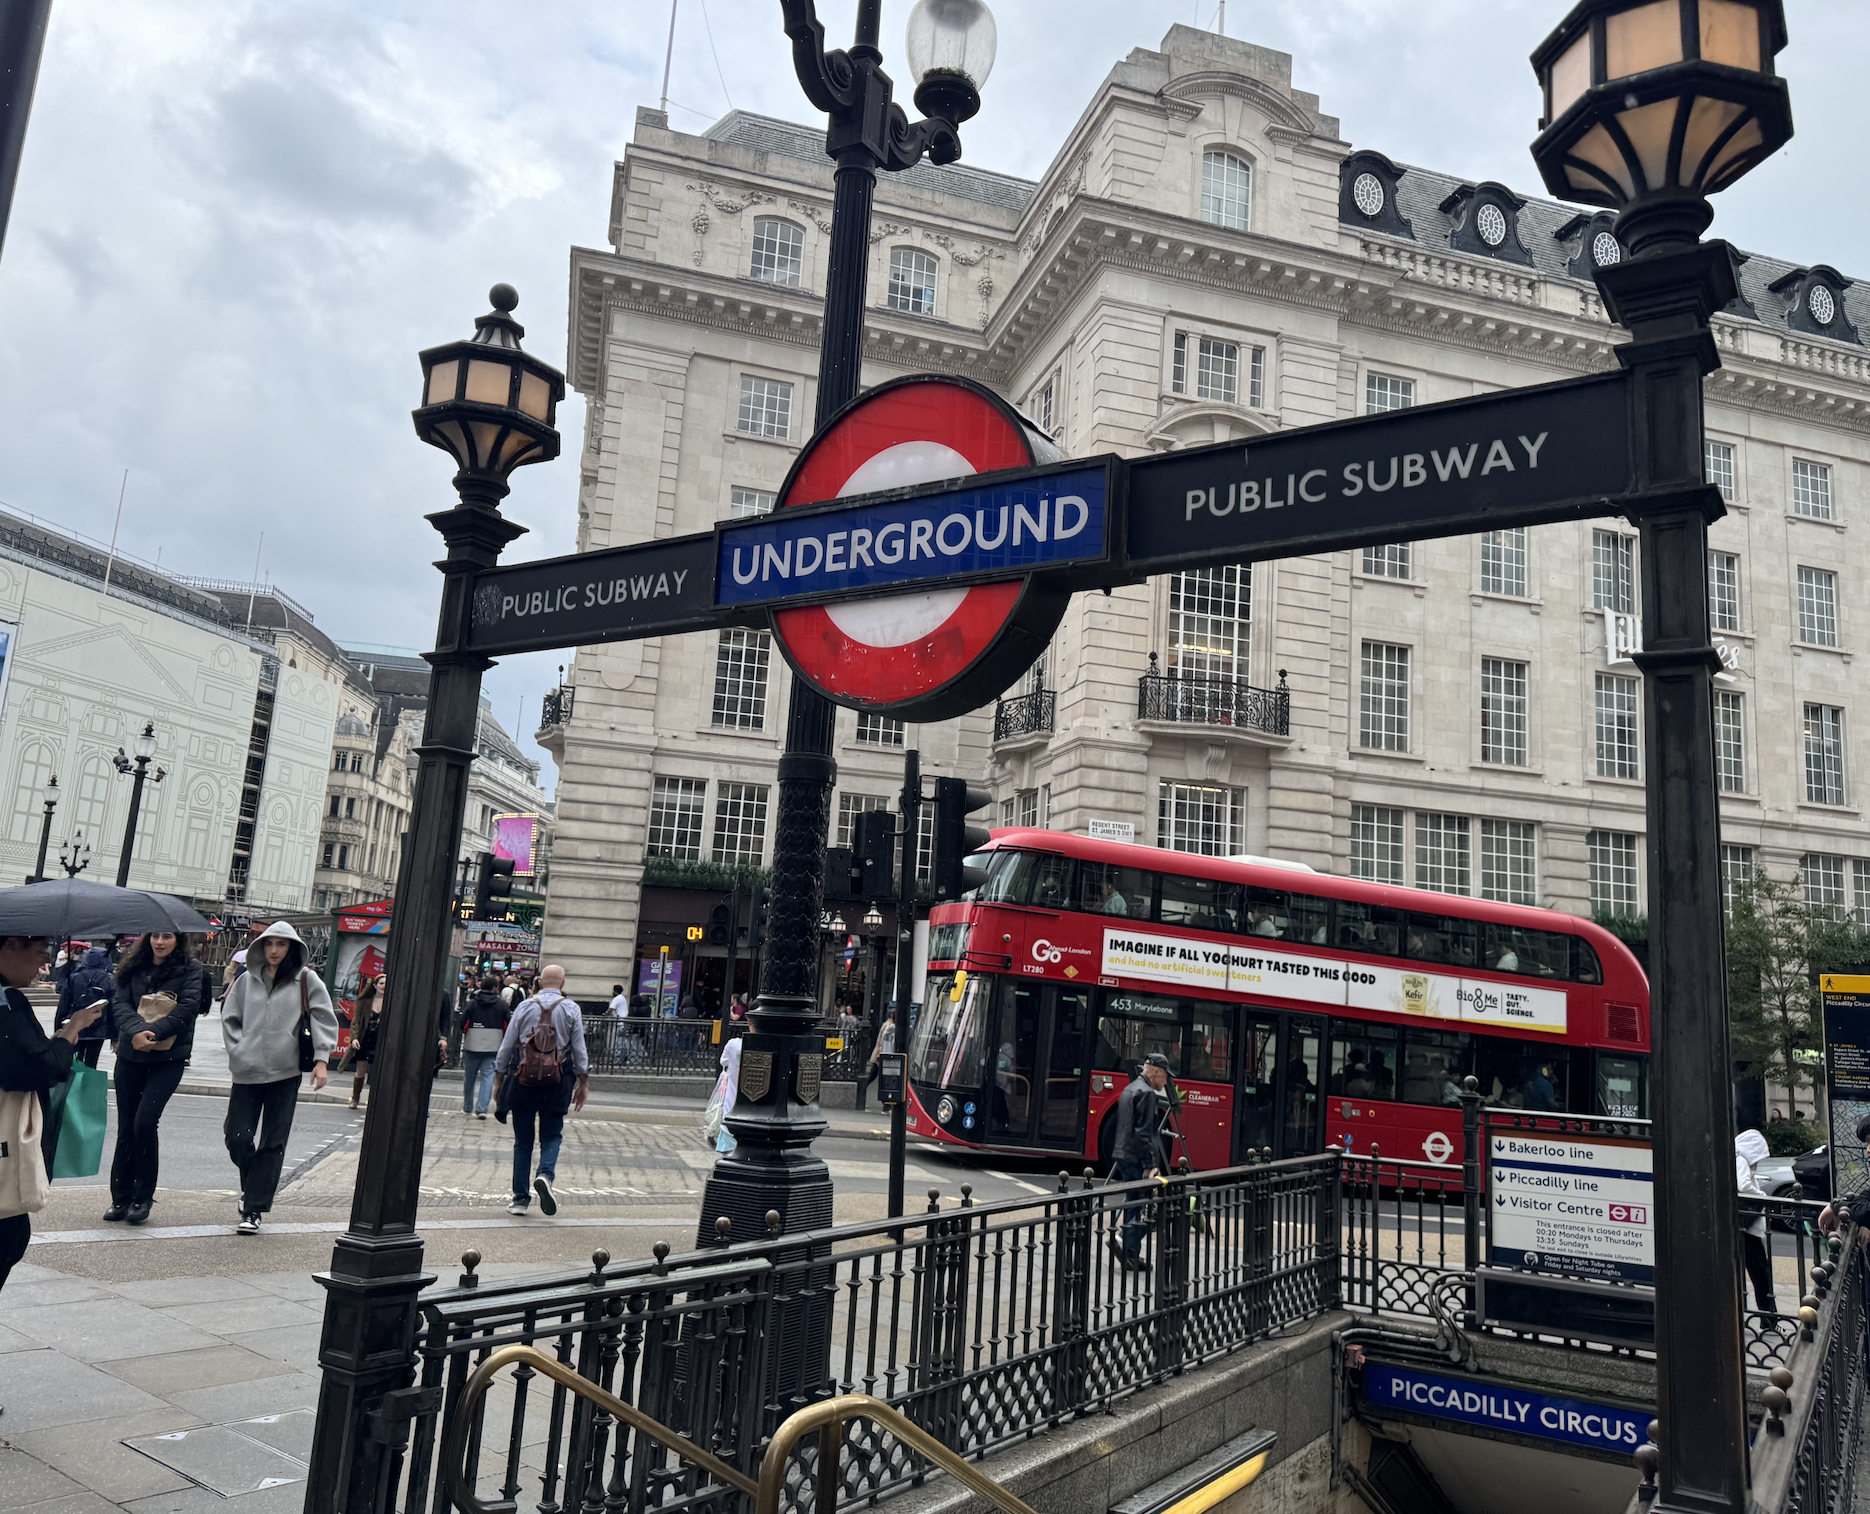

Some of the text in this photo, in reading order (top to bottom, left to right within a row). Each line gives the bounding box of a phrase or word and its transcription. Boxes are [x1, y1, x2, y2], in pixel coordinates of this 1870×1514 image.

[1185, 431, 1549, 522] PUBLIC SUBWAY
[732, 495, 1090, 586] UNDERGROUND
[501, 569, 689, 619] PUBLIC SUBWAY
[1091, 821, 1130, 831] REGENT STREET
[687, 926, 703, 940] 04
[478, 942, 513, 951] MASALA
[1031, 938, 1062, 964] Go
[1068, 946, 1092, 955] London
[650, 961, 674, 970] GAE
[1022, 964, 1045, 974] LT280
[1108, 956, 1127, 965] and
[1128, 956, 1147, 968] had
[1149, 960, 1160, 970] no
[1161, 961, 1205, 976] artificial
[1109, 938, 1377, 985] IMAGINE IF ALL YOGHURT TASTED THIS GOOD
[1405, 989, 1424, 1000] Kefir
[1456, 988, 1498, 1013] Bio&Me
[1505, 993, 1530, 1003] TASTY.
[1110, 998, 1174, 1015] 453 Marylebone
[1505, 1008, 1536, 1018] SCIENCE.
[1509, 1141, 1594, 1160] Bakerloo line
[1509, 1172, 1599, 1192] Piccadilly line
[1509, 1195, 1553, 1211] Visitor
[1557, 1201, 1604, 1217] Centre
[1536, 1220, 1643, 1239] This entrance is closed after
[1536, 1228, 1644, 1248] 00:20 Mondays to Thursdays
[1536, 1236, 1590, 1249] 23:35 Sundays
[1544, 1254, 1561, 1264] Open
[1561, 1256, 1571, 1264] for
[1572, 1258, 1589, 1267] Night
[1590, 1260, 1606, 1268] Tube
[1594, 1251, 1614, 1259] outside
[1544, 1260, 1622, 1277] Friday and Saturday nights
[1391, 1378, 1639, 1445] PICCADILLY CIRCUS
